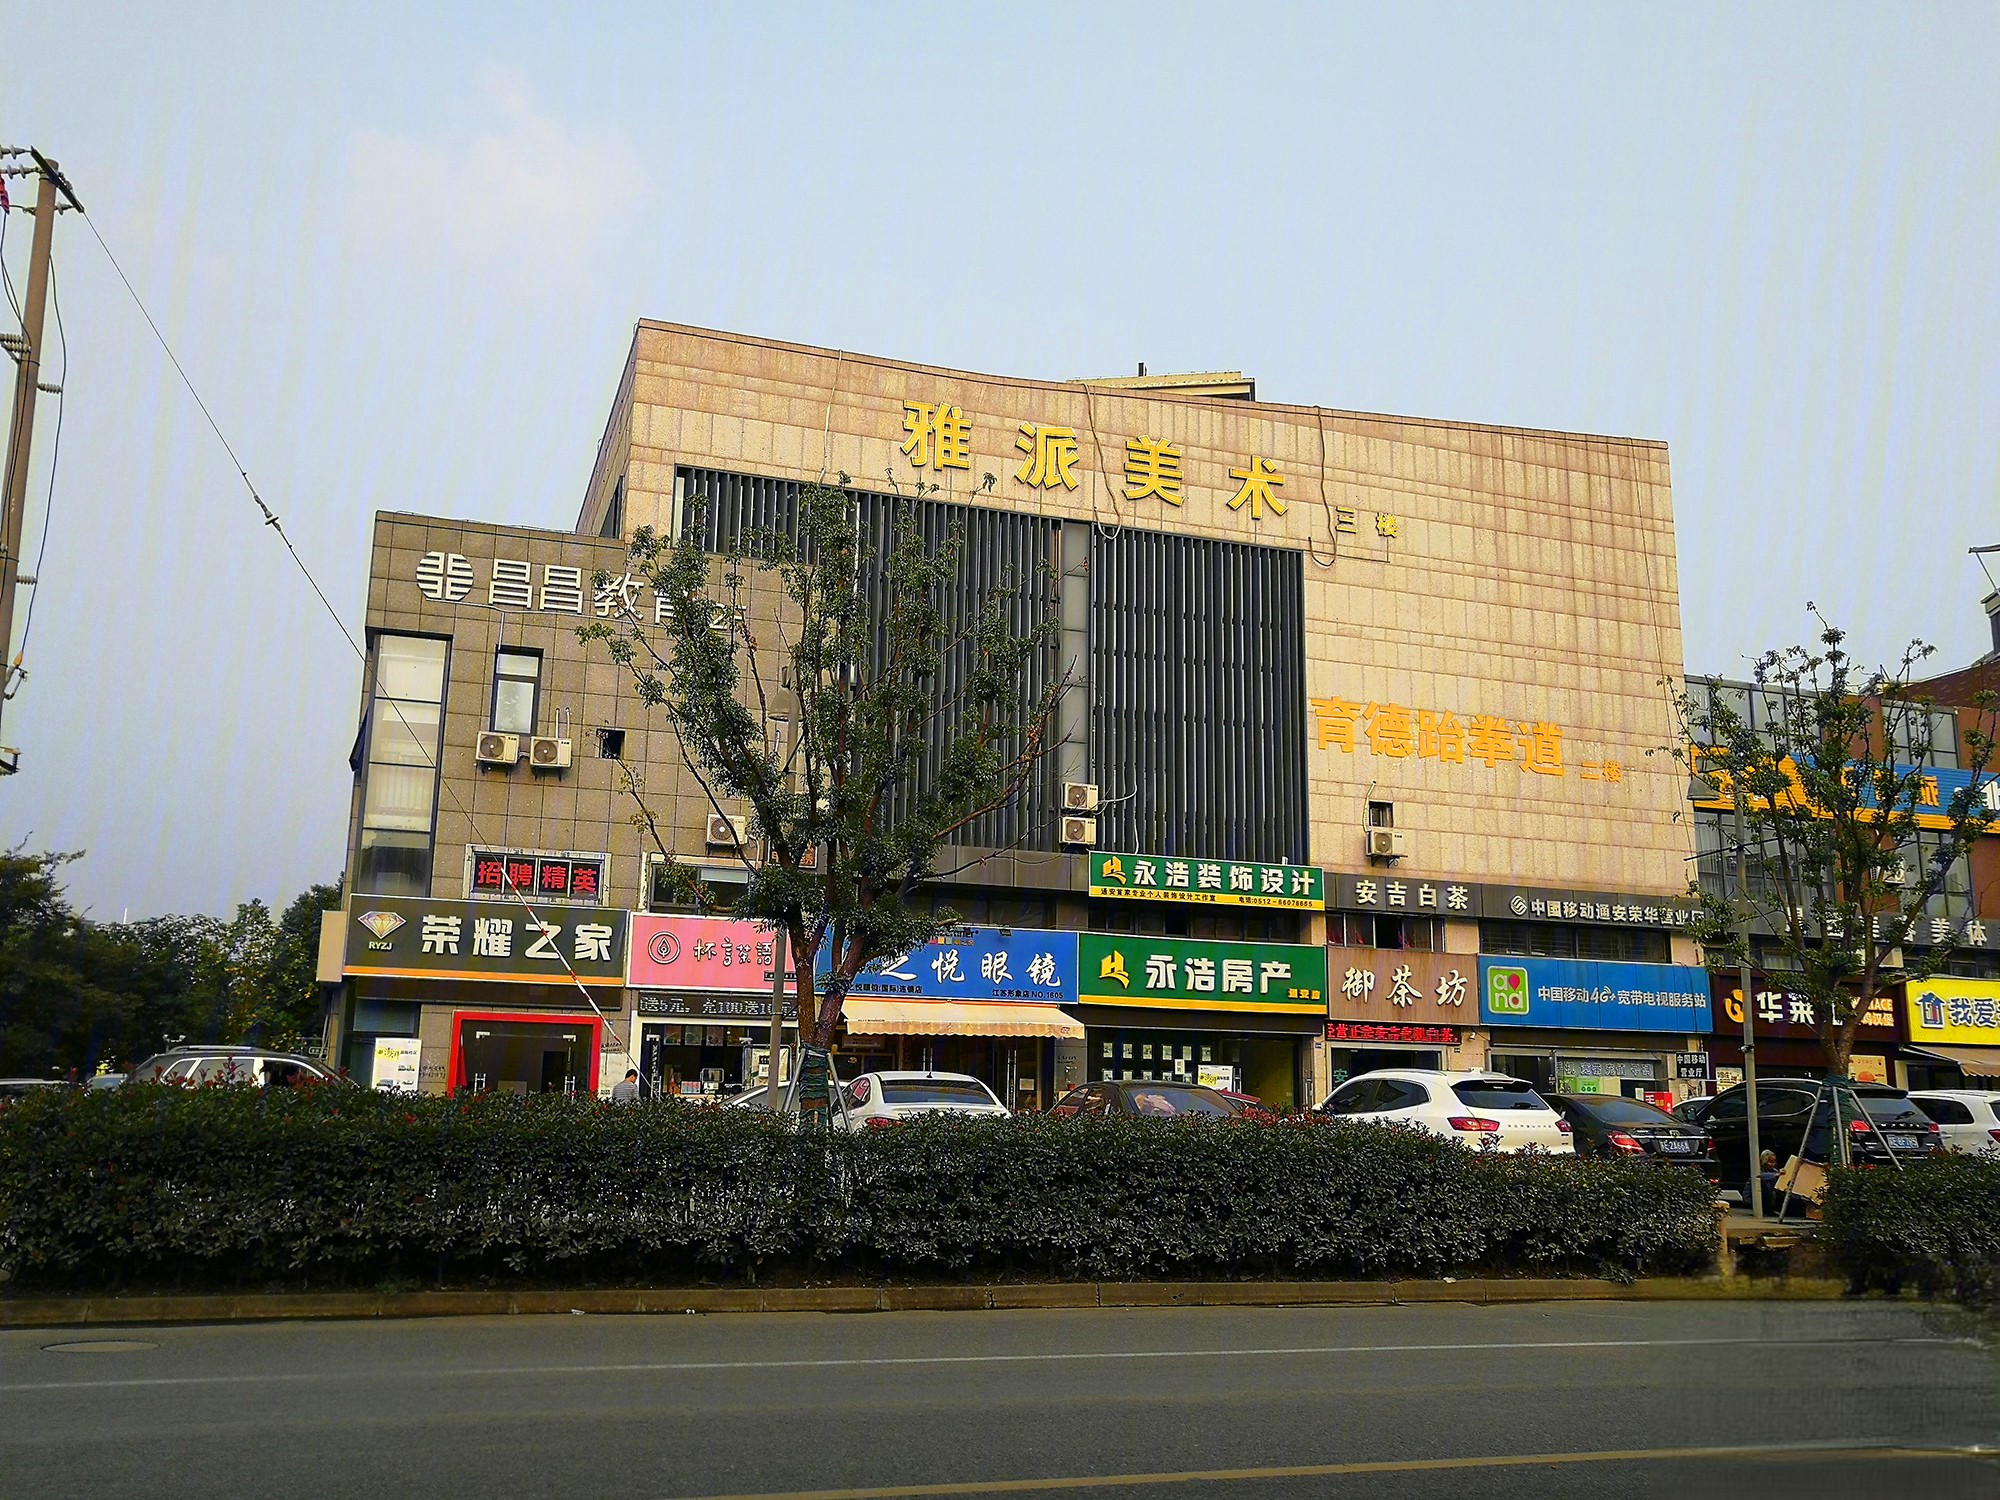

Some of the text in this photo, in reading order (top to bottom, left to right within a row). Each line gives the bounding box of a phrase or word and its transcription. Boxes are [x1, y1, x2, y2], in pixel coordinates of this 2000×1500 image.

[901, 399, 1399, 539] 雅派美术 三楼
[1310, 695, 1623, 784] 育德跆拳道 二楼
[477, 860, 597, 894] 招聘精英
[1133, 859, 1315, 896] 永浩装饰设计
[1355, 879, 1469, 910] 安吉白茶
[368, 941, 393, 951] RYZJ
[421, 914, 613, 962] 荣耀之家
[842, 947, 1062, 987] 之悦眼镜
[1145, 954, 1292, 994] 永浩房产
[992, 989, 1030, 998] 江苏形象店
[1341, 964, 1469, 1008] 御茶坊
[1947, 996, 2000, 1028] 我爱
[1605, 1062, 1627, 1076] 充值
[1676, 1055, 1706, 1065] 中国移动
[1680, 1067, 1703, 1078] 营业厅
